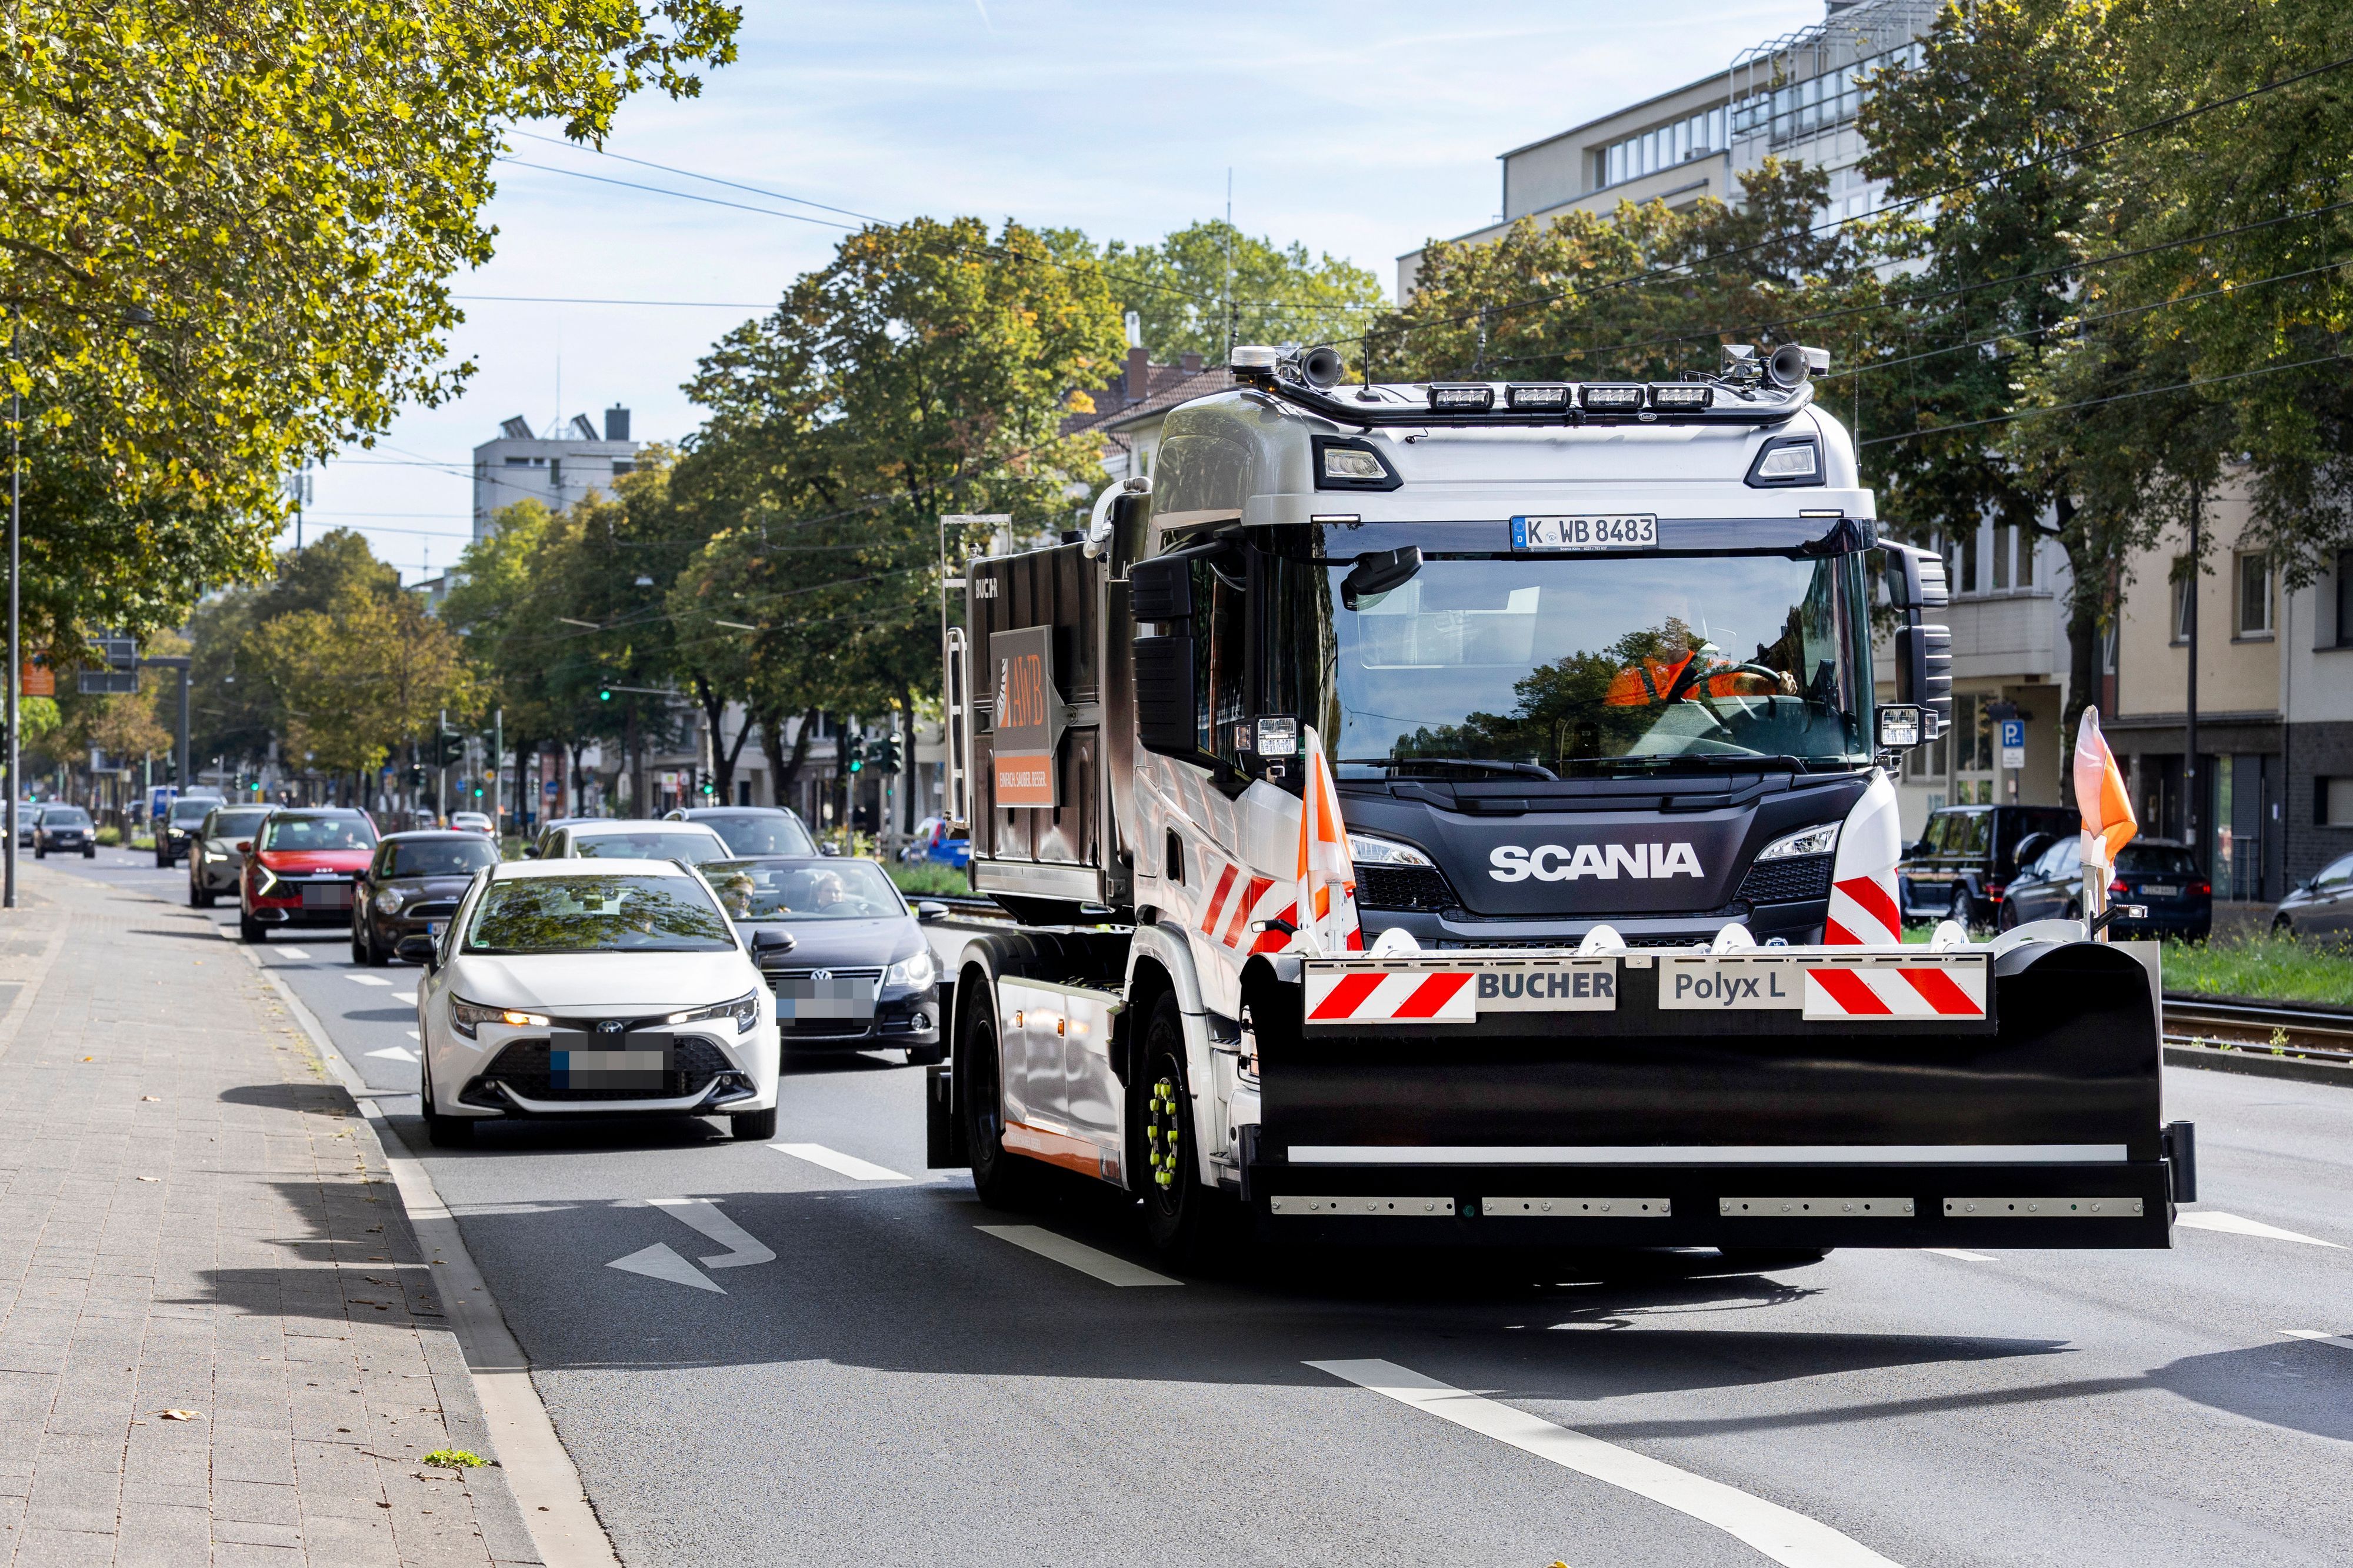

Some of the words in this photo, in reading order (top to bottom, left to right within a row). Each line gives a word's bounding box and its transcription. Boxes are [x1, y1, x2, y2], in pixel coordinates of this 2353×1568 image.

[1528, 521, 1542, 543] K
[1559, 521, 1589, 542] WB
[1596, 519, 1652, 542] 8483
[1012, 653, 1044, 728] AWB
[2005, 723, 2018, 745] P
[1489, 843, 1705, 882] SCANIA
[1478, 972, 1615, 999] BUCHER
[1675, 971, 1760, 1006] Polyx
[1770, 972, 1786, 997] L
